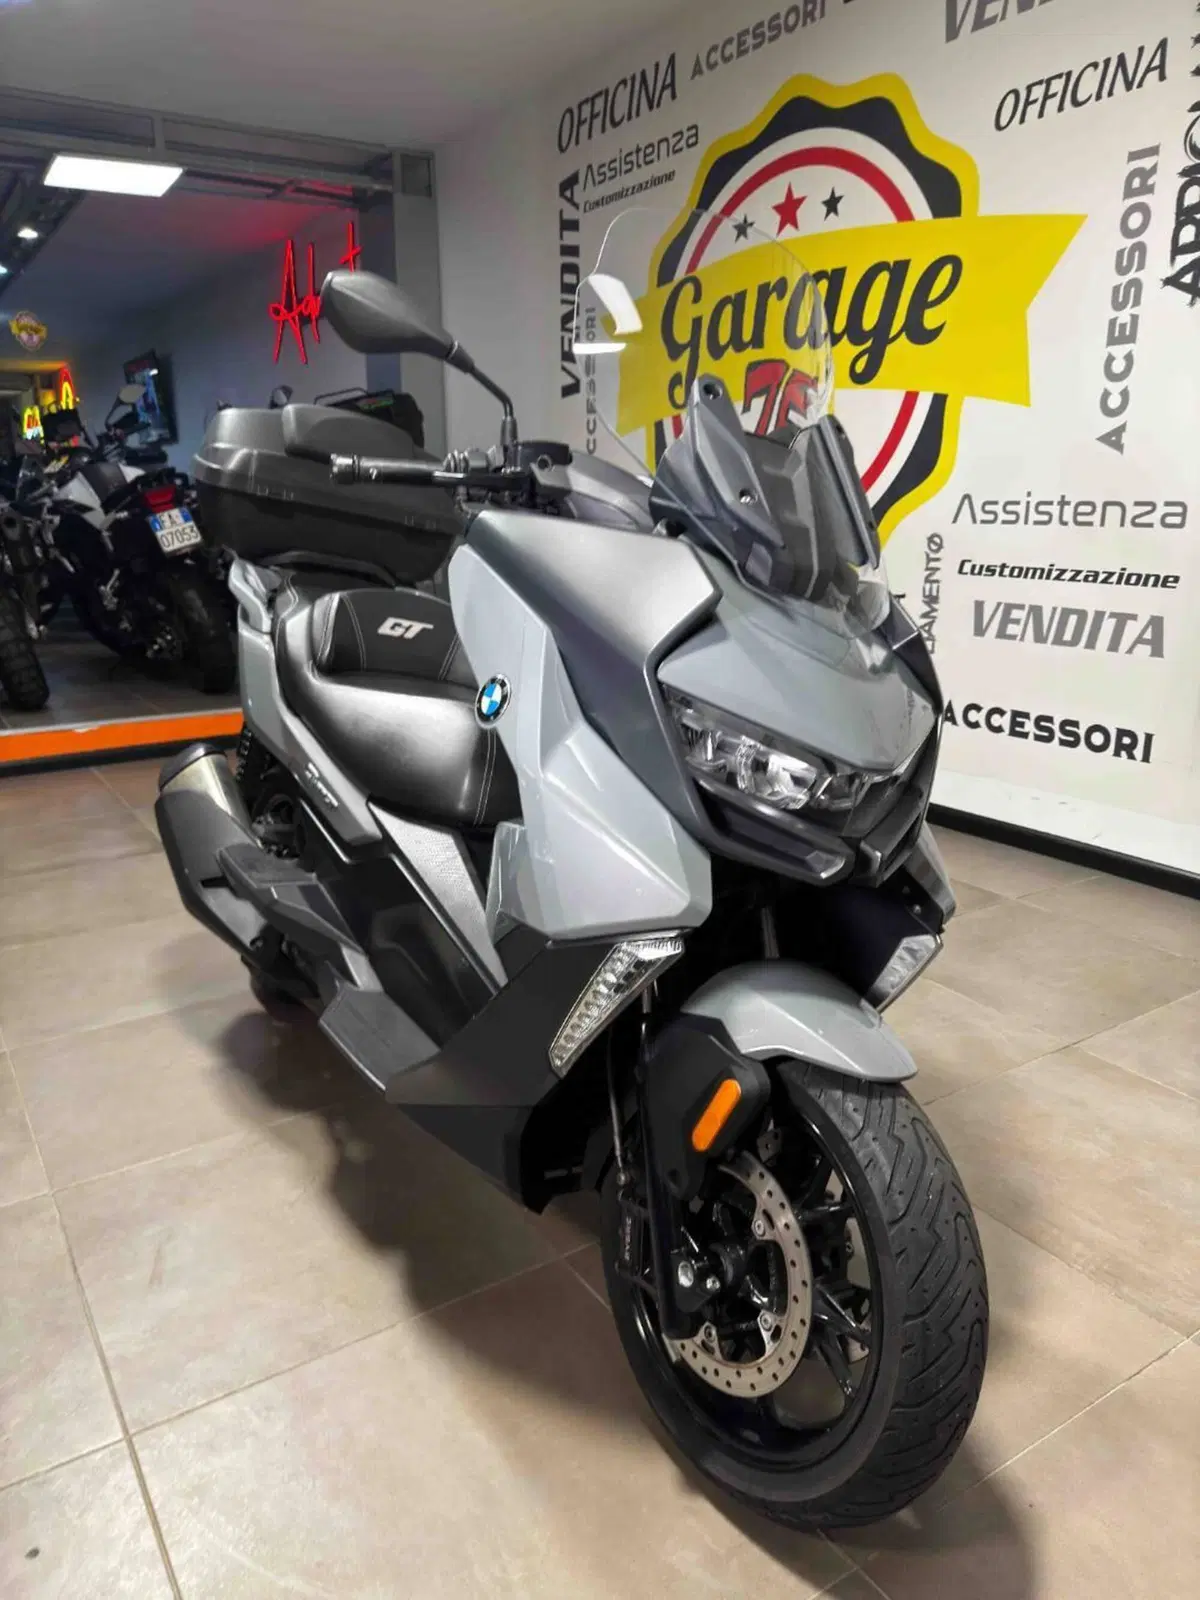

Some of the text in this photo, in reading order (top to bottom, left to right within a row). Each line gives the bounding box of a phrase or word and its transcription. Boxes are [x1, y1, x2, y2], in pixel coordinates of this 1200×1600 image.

[557, 52, 678, 154] OFFICINA
[994, 37, 1168, 131] OFFICINA
[582, 123, 699, 191] Assistenza
[583, 170, 676, 213] Customizzazione
[1095, 142, 1161, 455] ACCESSORI
[660, 254, 963, 410] Garage
[951, 491, 1188, 529] Assistenza
[957, 559, 1180, 589] Customizzazione
[377, 617, 434, 639] GT
[972, 600, 1165, 658] VENDITA
[943, 699, 1155, 763] ACCESSORI
